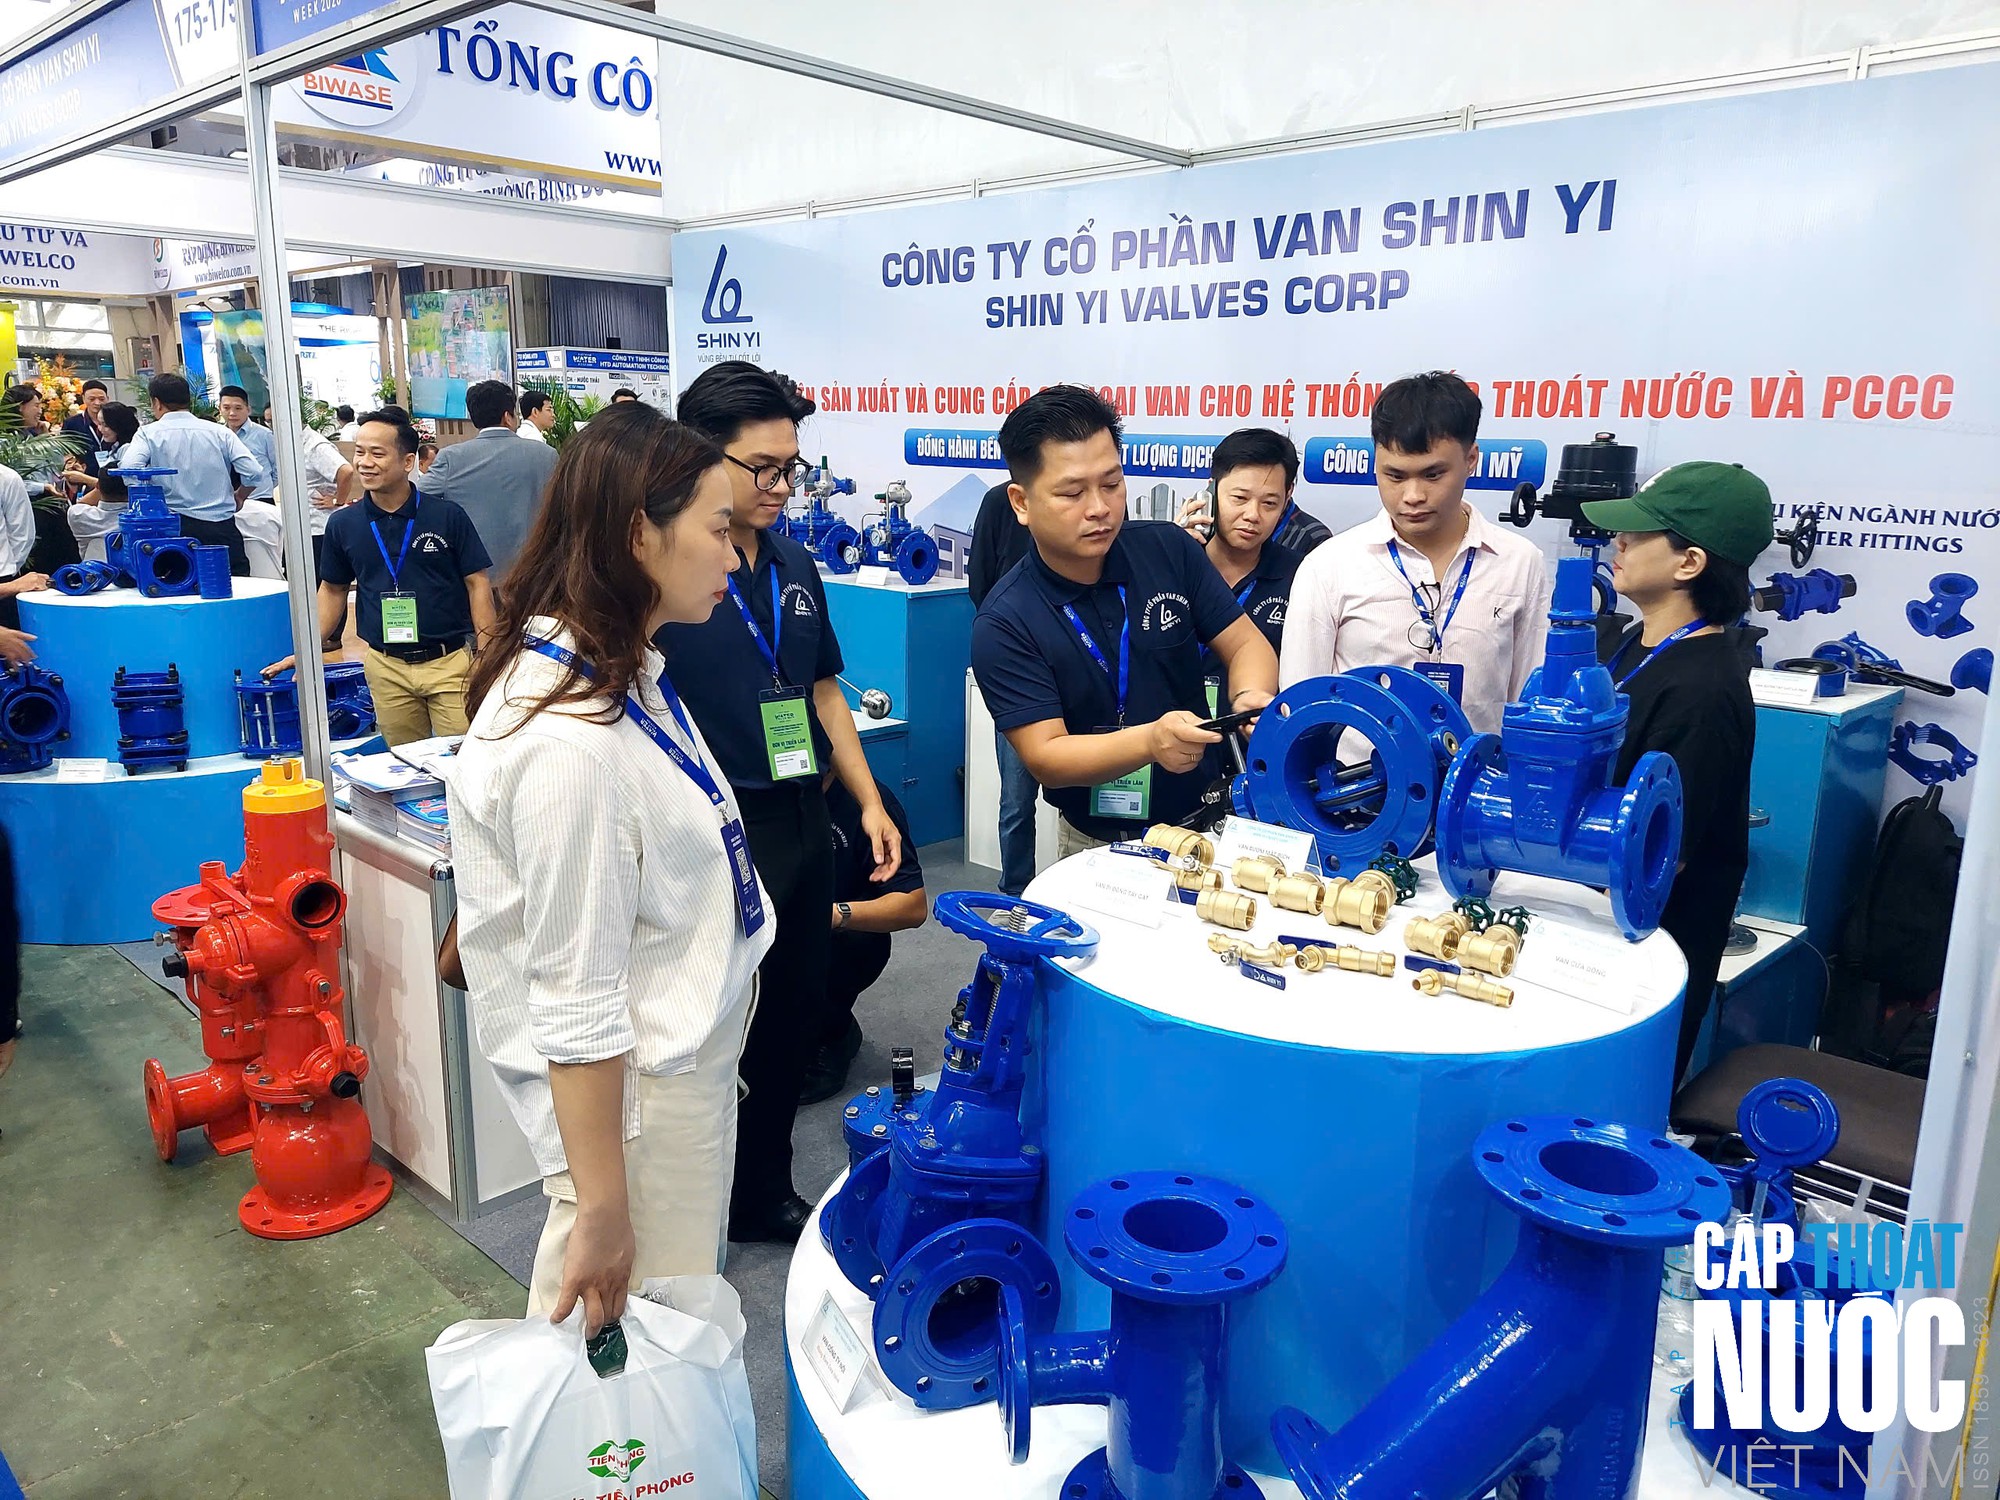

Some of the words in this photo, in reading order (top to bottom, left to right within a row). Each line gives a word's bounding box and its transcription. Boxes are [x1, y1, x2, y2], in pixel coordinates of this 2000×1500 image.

[292, 0, 319, 24] WEEK
[41, 53, 63, 88] VAN
[63, 40, 89, 78] SHIN
[88, 32, 100, 64] YI
[425, 20, 577, 98] TỔNG
[304, 73, 392, 104] BIWASE
[0, 225, 15, 241] U
[21, 227, 55, 244] TƯ
[882, 242, 975, 287] CÔNG
[987, 240, 1032, 280] TY
[1044, 218, 1096, 276] CỔ
[1111, 213, 1236, 271] PHẦN
[1253, 207, 1361, 260] VAN
[1382, 189, 1530, 249] SHIN
[1555, 179, 1617, 234] YI
[986, 293, 1063, 328] SHIN
[1076, 290, 1107, 324] YI
[1121, 279, 1269, 323] VALVES
[1284, 269, 1410, 315] CORP
[697, 332, 740, 348] SHIN
[743, 331, 761, 348] YI
[611, 362, 647, 370] AUTOMATION
[612, 353, 628, 362] CÔNG
[821, 380, 853, 412] SẢN
[857, 377, 900, 413] XUẤT
[905, 382, 928, 414] VÀ
[934, 386, 985, 415] CUNG
[1145, 385, 1191, 417] VAN
[1199, 385, 1253, 417] CHO
[1262, 378, 1296, 424] HỆ
[1305, 371, 1383, 418] THỐN
[1492, 373, 1609, 418] THOÁT
[1619, 370, 1733, 418] NƯỚC
[1750, 370, 1804, 419] VÀ
[1821, 374, 1955, 420] PCCC
[916, 433, 945, 458] ĐỒNG
[948, 434, 977, 460] HÀNH
[1132, 443, 1178, 472] LƯỢNG
[1323, 442, 1369, 475] CÔNG
[1488, 446, 1523, 479] MỸ
[1849, 503, 1936, 526] NGÀNH
[1859, 533, 1964, 554] FITTINGS
[1494, 606, 1502, 619] K
[1555, 955, 1570, 965] VAN
[635, 1472, 695, 1498] PHONG
